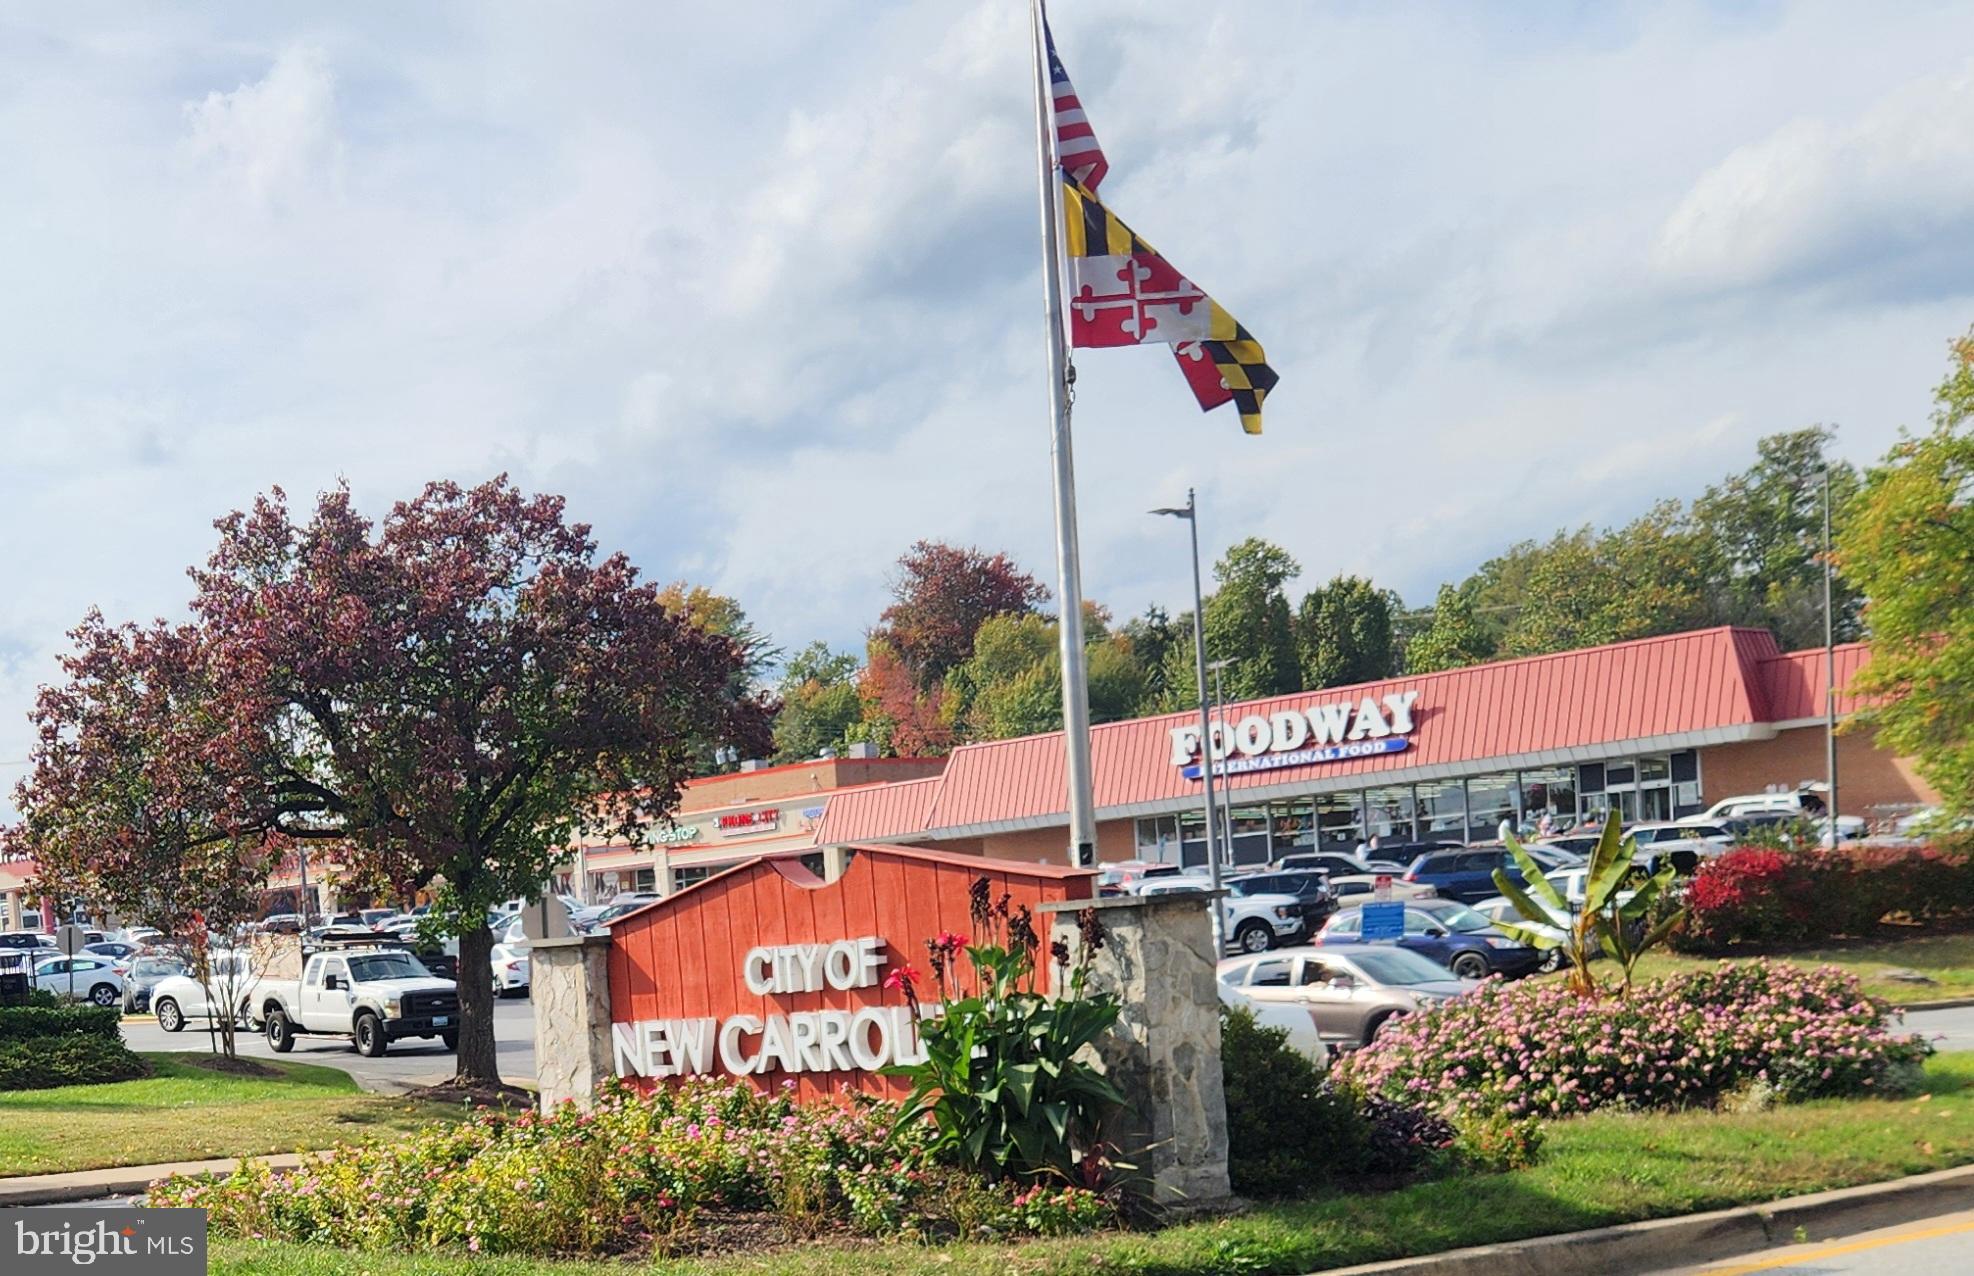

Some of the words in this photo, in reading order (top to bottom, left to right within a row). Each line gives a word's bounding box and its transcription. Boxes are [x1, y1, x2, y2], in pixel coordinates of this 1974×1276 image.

[1170, 691, 1418, 765] FOODWAY
[1338, 741, 1387, 759] FOOD
[643, 827, 697, 844] INGSTOP
[744, 943, 825, 996] CITY
[823, 935, 888, 991] OF
[611, 1016, 717, 1079] NEW
